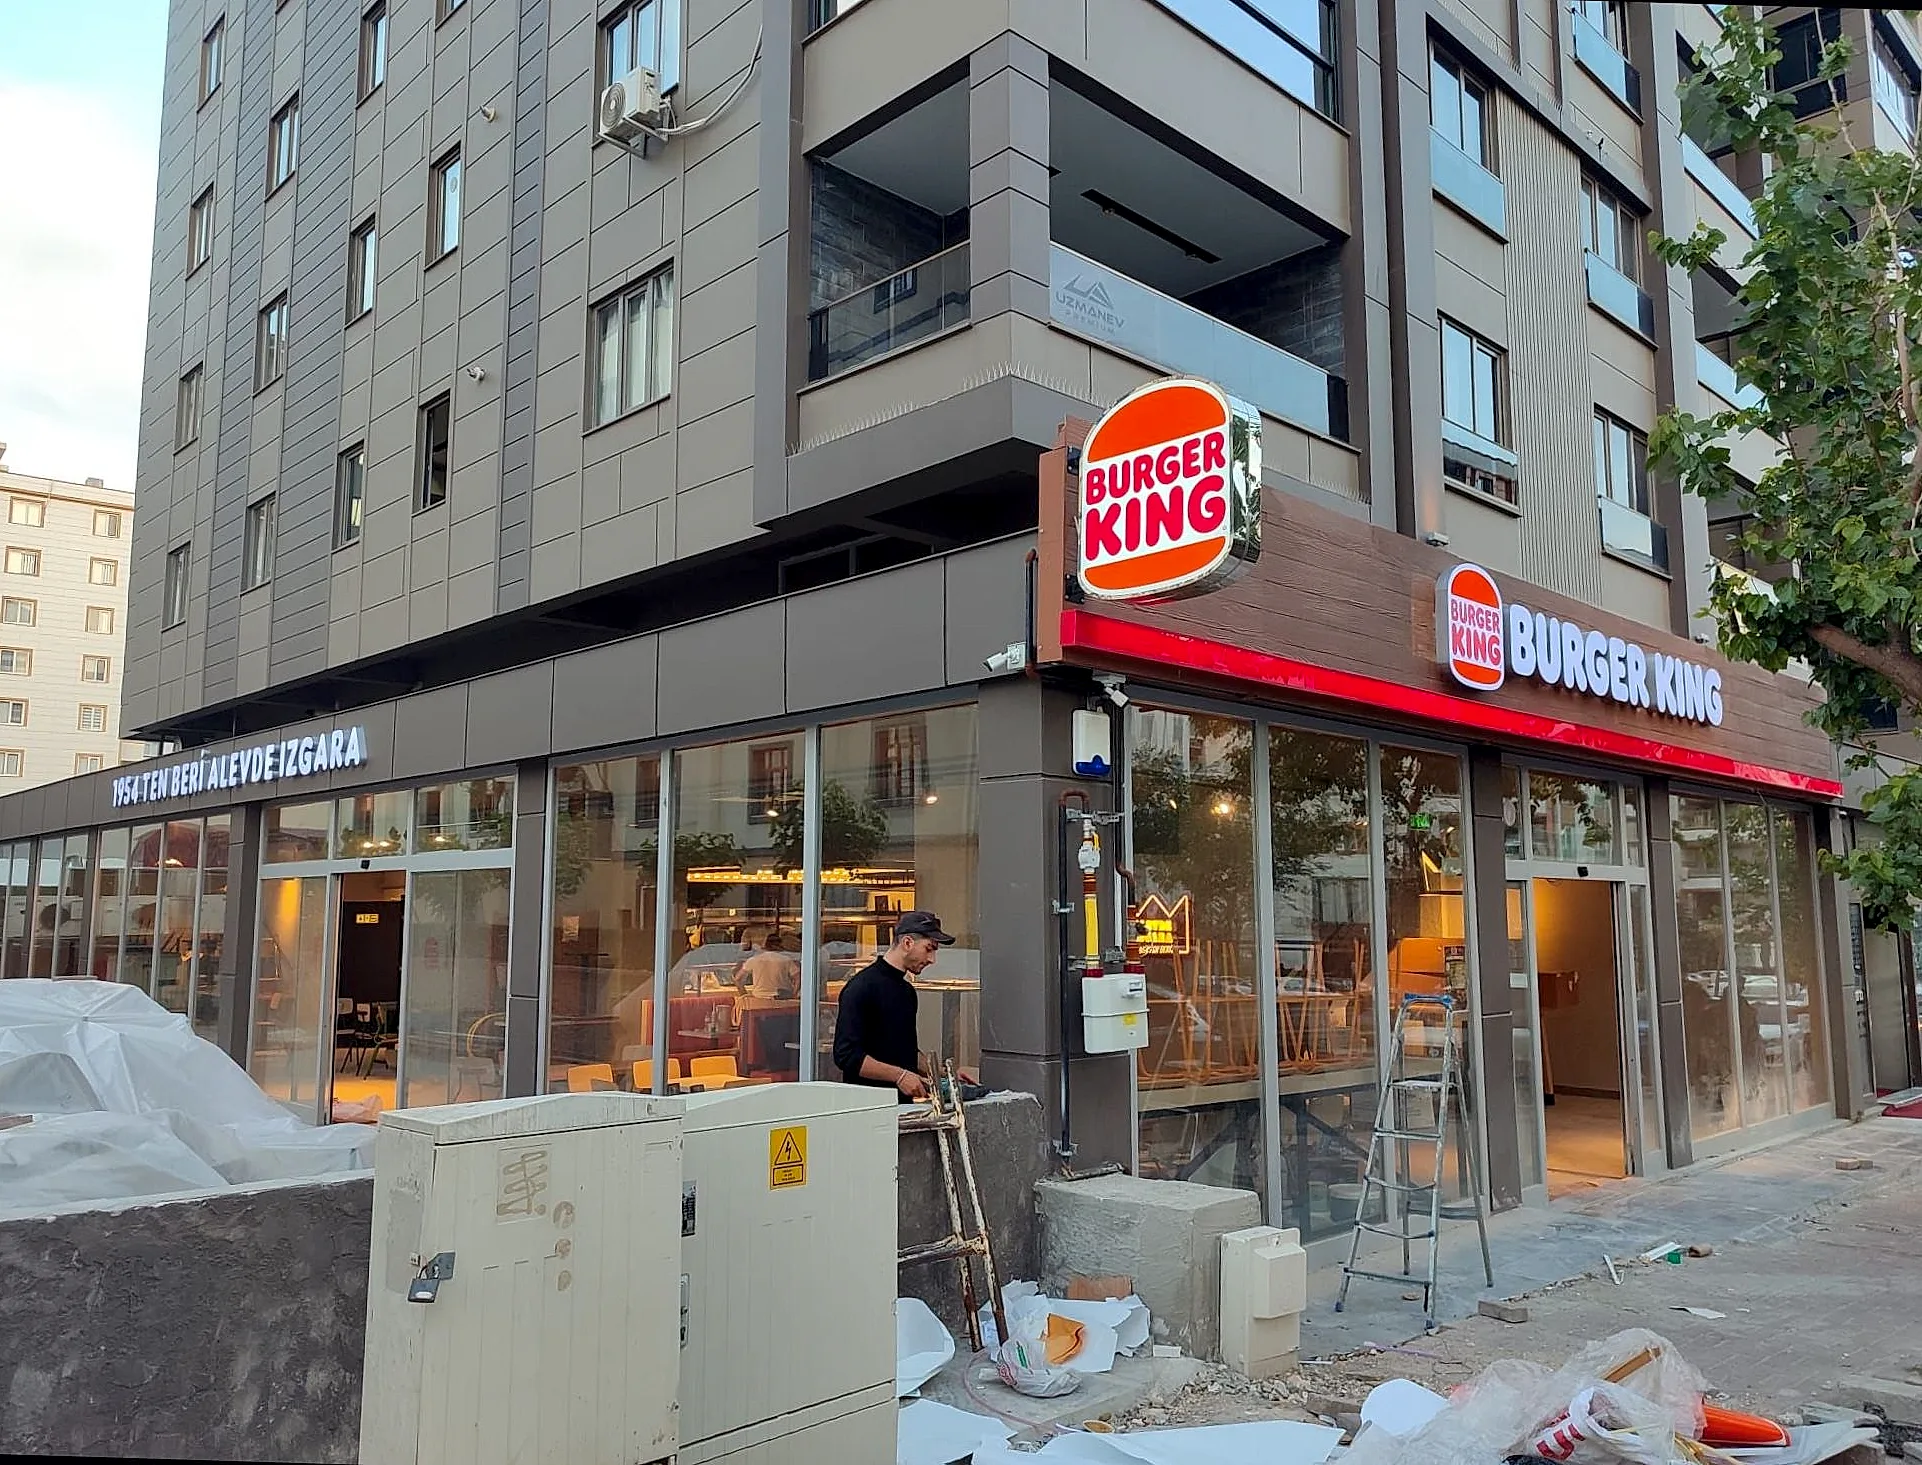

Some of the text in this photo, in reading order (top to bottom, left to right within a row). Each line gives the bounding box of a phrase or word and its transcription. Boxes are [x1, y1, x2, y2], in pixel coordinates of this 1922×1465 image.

[1056, 291, 1124, 328] UZMANEV
[1086, 431, 1226, 506] BURGER
[1085, 474, 1227, 561] KING
[1451, 598, 1500, 634] BURGER
[1451, 622, 1502, 666] KING
[1509, 603, 1724, 728] BURGER KING
[112, 775, 139, 808] 1954
[143, 767, 169, 802] TEN
[207, 744, 275, 790] ALEVDE
[279, 726, 361, 778] IZGARA
